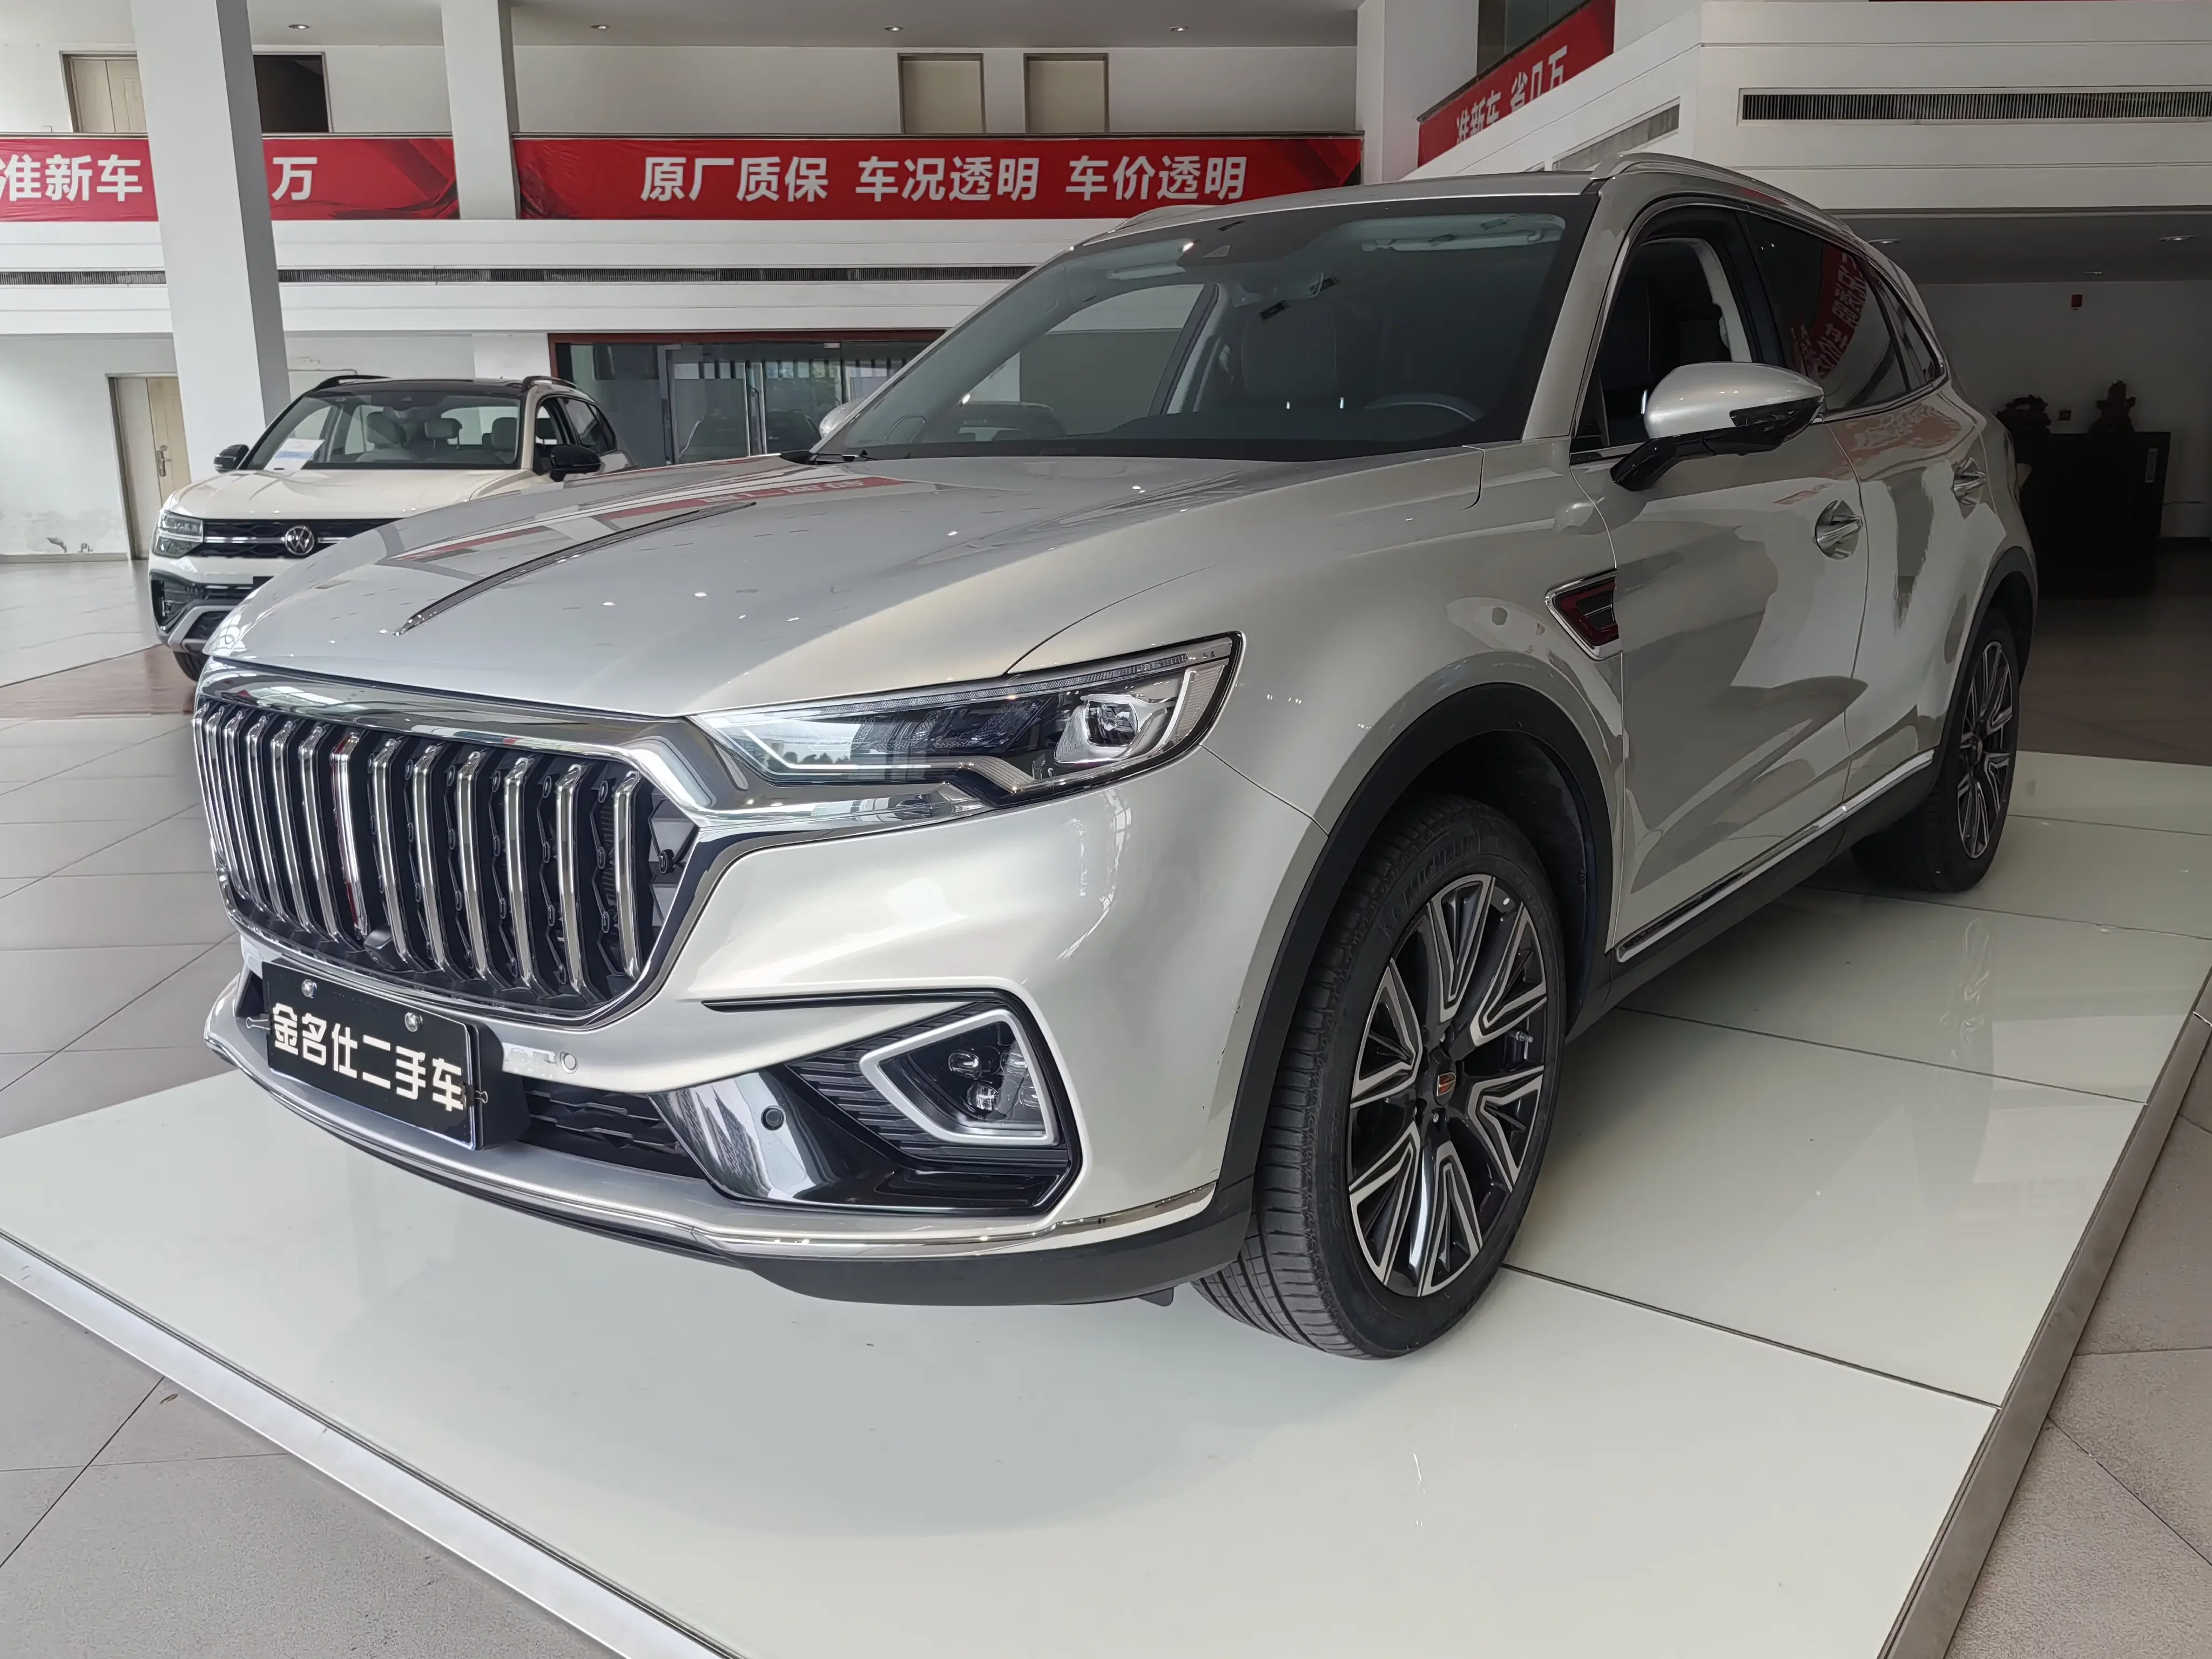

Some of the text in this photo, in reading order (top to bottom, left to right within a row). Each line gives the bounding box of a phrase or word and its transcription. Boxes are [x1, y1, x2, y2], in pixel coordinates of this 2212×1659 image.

[272, 157, 318, 200] 万
[640, 156, 1248, 202] 原厂质保 车况透明 车价透明
[272, 1002, 463, 1112] 金名仕二手车
